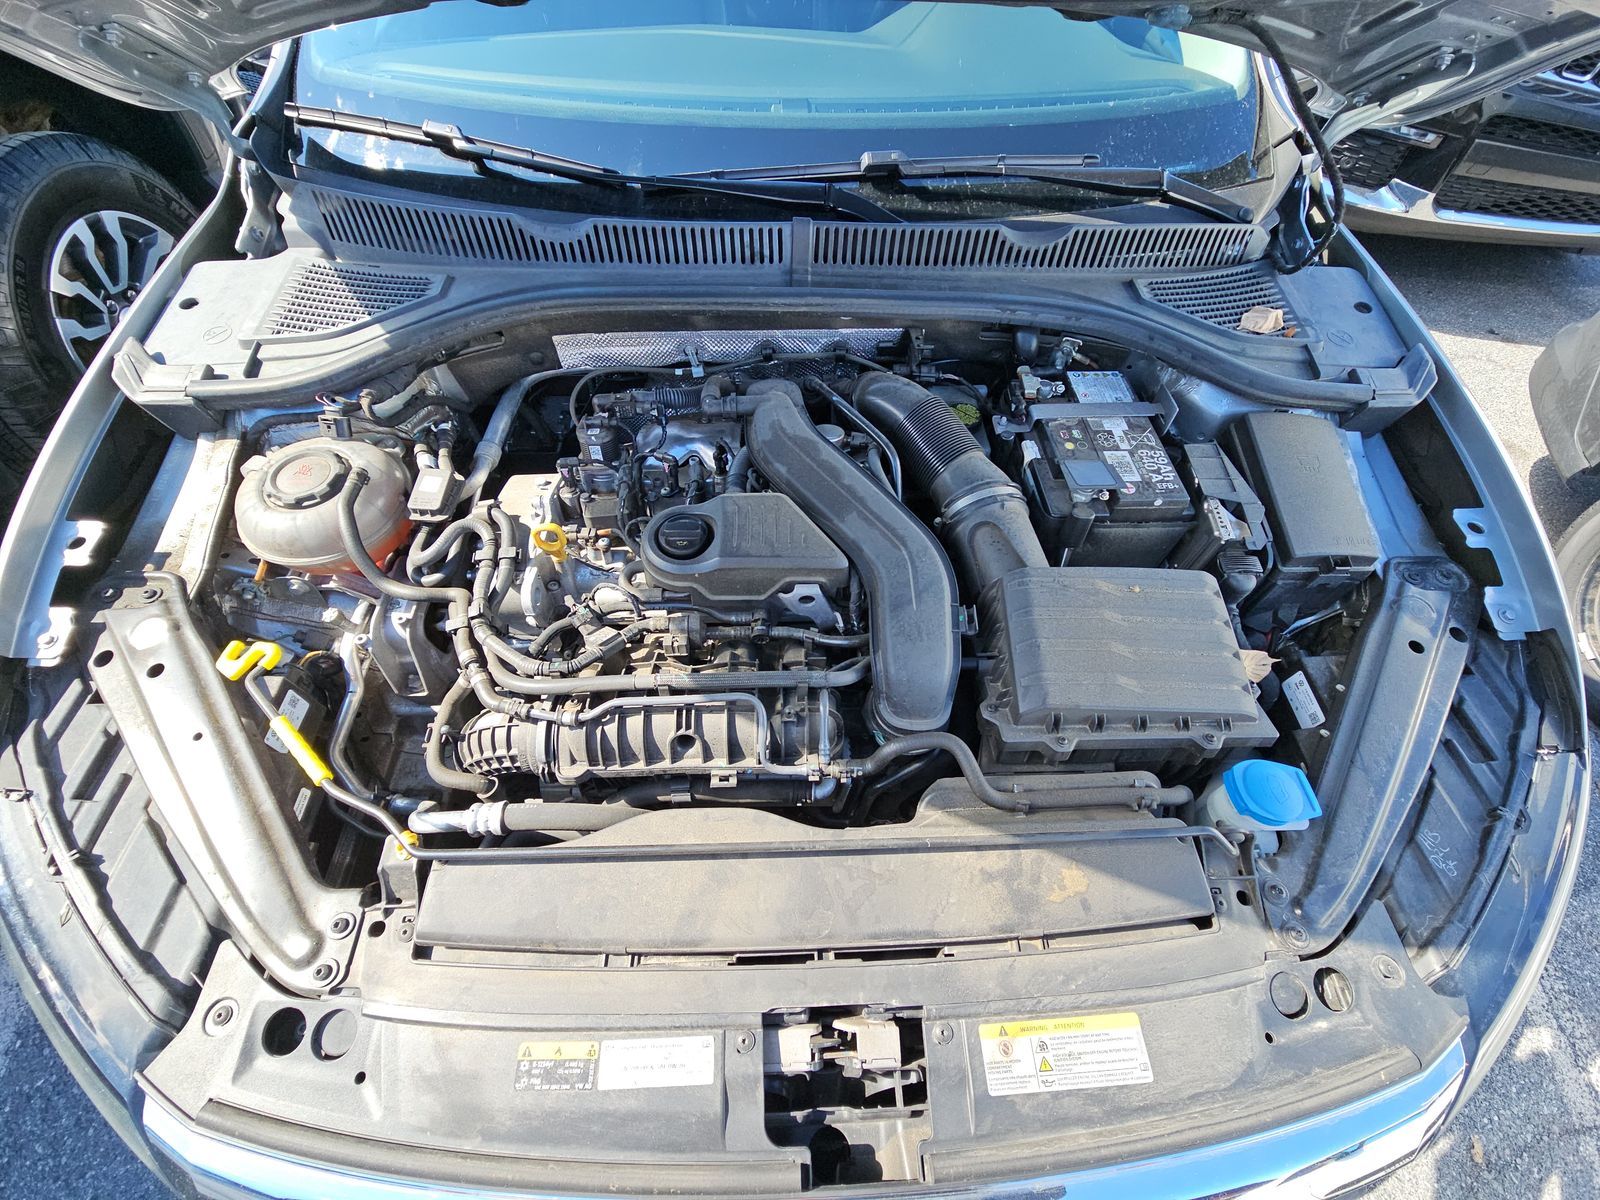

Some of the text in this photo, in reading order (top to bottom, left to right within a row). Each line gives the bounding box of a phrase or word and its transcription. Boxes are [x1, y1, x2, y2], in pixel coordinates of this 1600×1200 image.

[1138, 450, 1158, 470] 640
[1148, 472, 1164, 483] A
[1151, 450, 1175, 481] 59Ah
[1157, 482, 1179, 490] EFB+
[1019, 1022, 1085, 1033] WARNING ATTENTION
